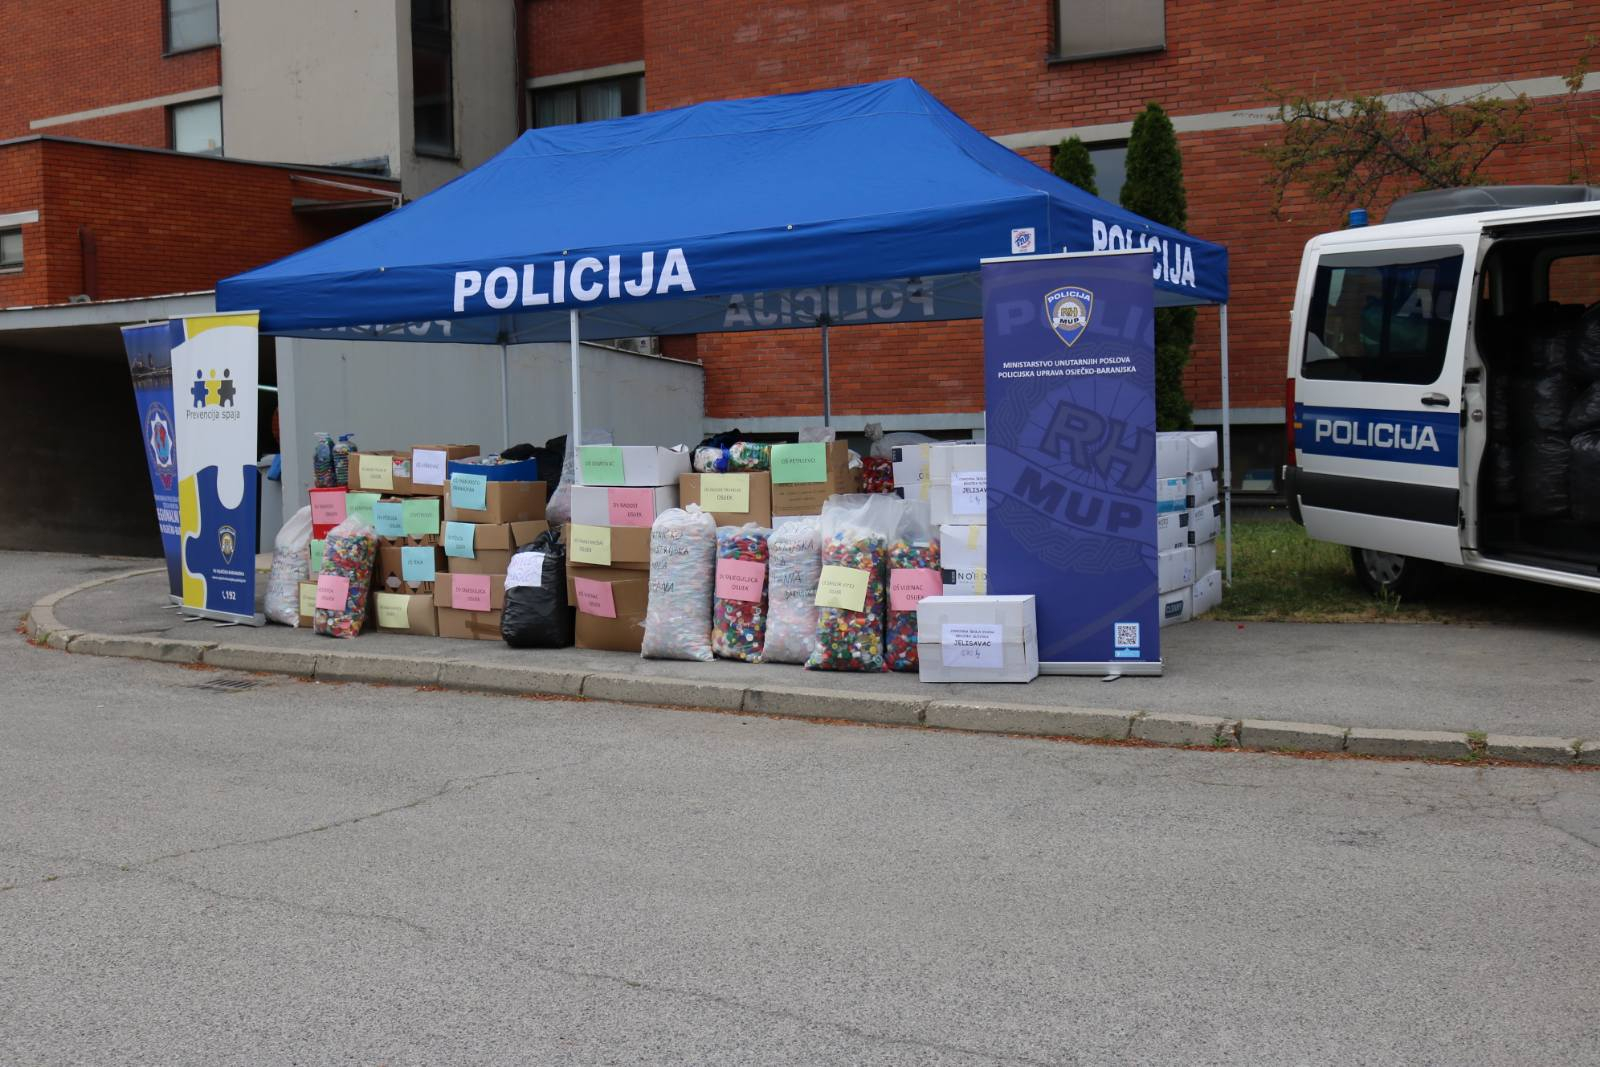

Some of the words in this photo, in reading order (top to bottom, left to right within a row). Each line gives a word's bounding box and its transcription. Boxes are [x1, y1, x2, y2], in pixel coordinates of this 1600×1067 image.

[453, 247, 697, 313] POLICIJA
[1047, 290, 1091, 304] POLICIJA
[1059, 317, 1080, 325] MUP
[1003, 361, 1053, 369] MINISTARSTVO
[1054, 358, 1098, 367] UNUTARNJIH
[1099, 356, 1131, 365] POSLOVA
[998, 370, 1035, 378] POLICIJSKA
[1036, 369, 1064, 377] UPRAVA
[1065, 366, 1137, 376] OSJEČKO-BARANJSKA
[186, 409, 220, 421] Prevencija
[221, 409, 241, 421] spaja
[1315, 419, 1440, 452] POLICIJA
[1040, 400, 1156, 493] RH
[1013, 466, 1143, 533] MUP
[225, 591, 237, 600] 192
